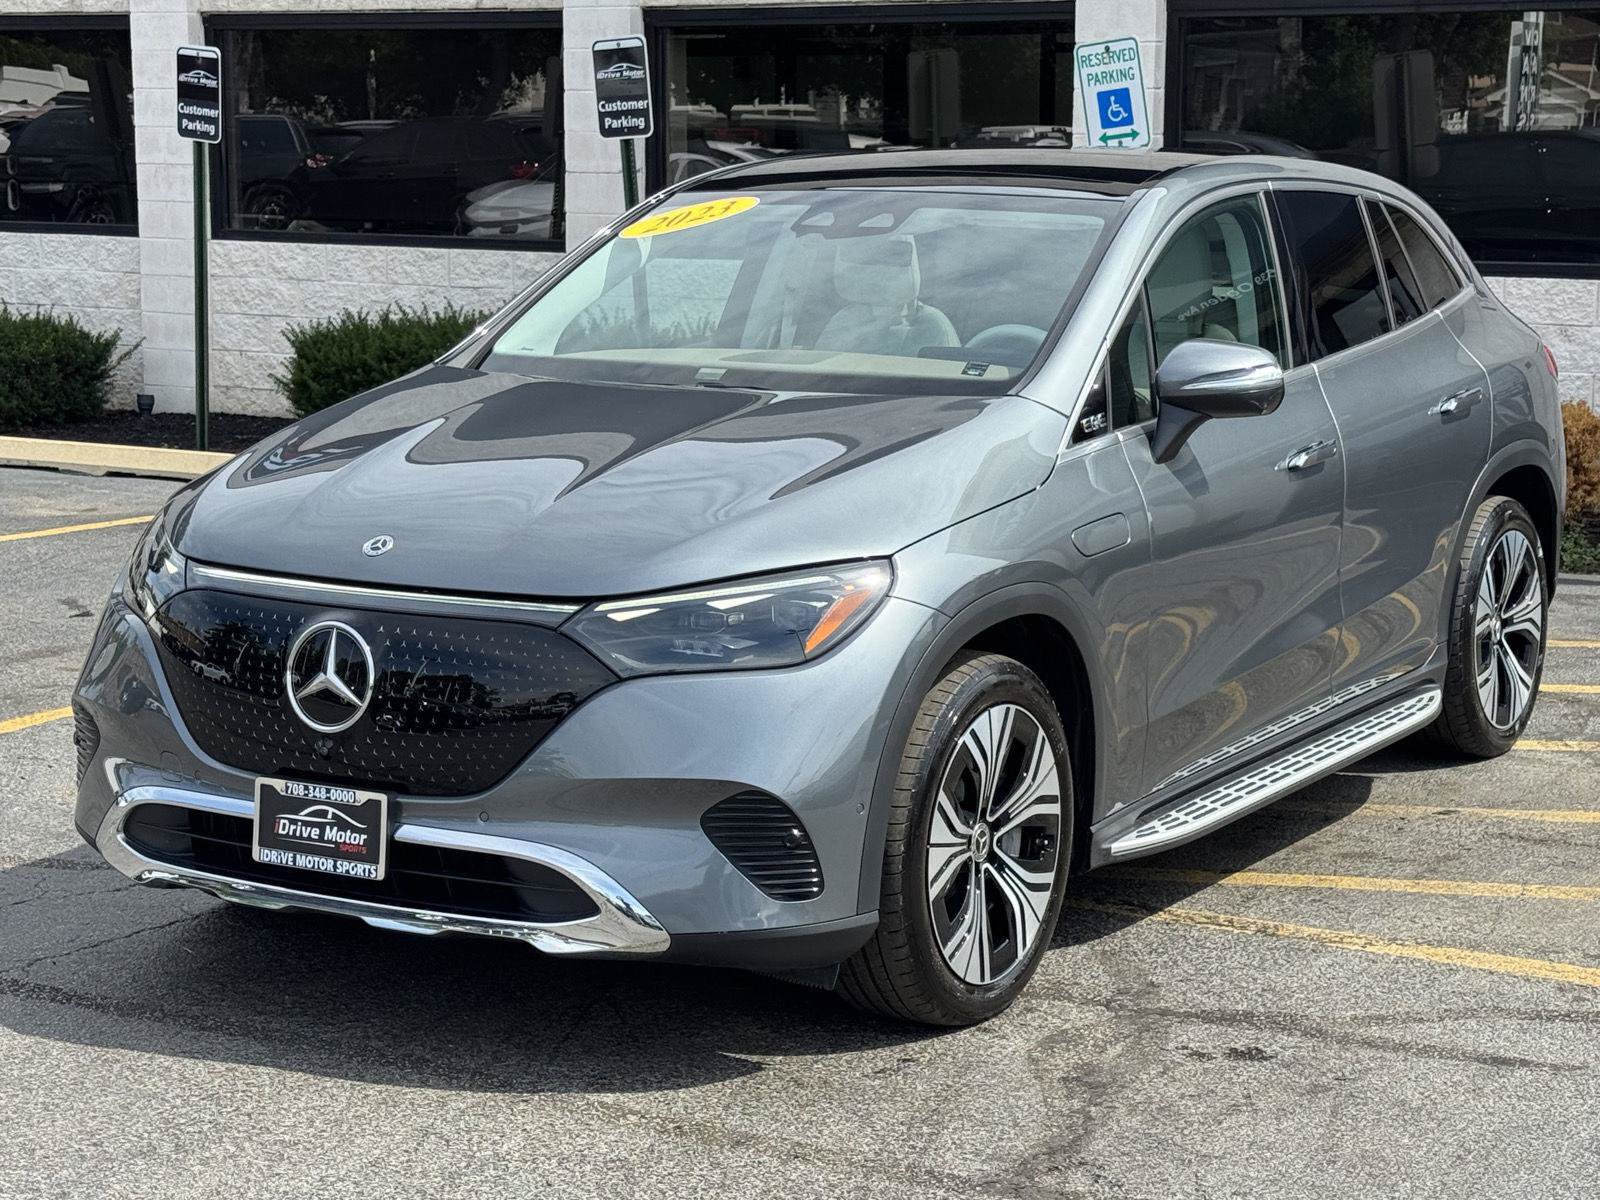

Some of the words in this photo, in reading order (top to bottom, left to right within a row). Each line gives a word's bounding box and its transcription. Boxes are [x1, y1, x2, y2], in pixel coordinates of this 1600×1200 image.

[1080, 47, 1136, 69] RESERVED
[1087, 67, 1135, 87] PARKING
[178, 102, 219, 118] Customer
[598, 100, 648, 112] Customer
[182, 119, 215, 135] Parking
[604, 115, 645, 129] Parking
[641, 200, 737, 233] 2023
[286, 782, 355, 803] 708-348-0000
[274, 818, 320, 839] iDrive
[324, 825, 367, 845] Motor
[339, 844, 367, 854] SPORTS
[296, 854, 334, 872] MOTOR
[336, 860, 377, 878] SPORTS
